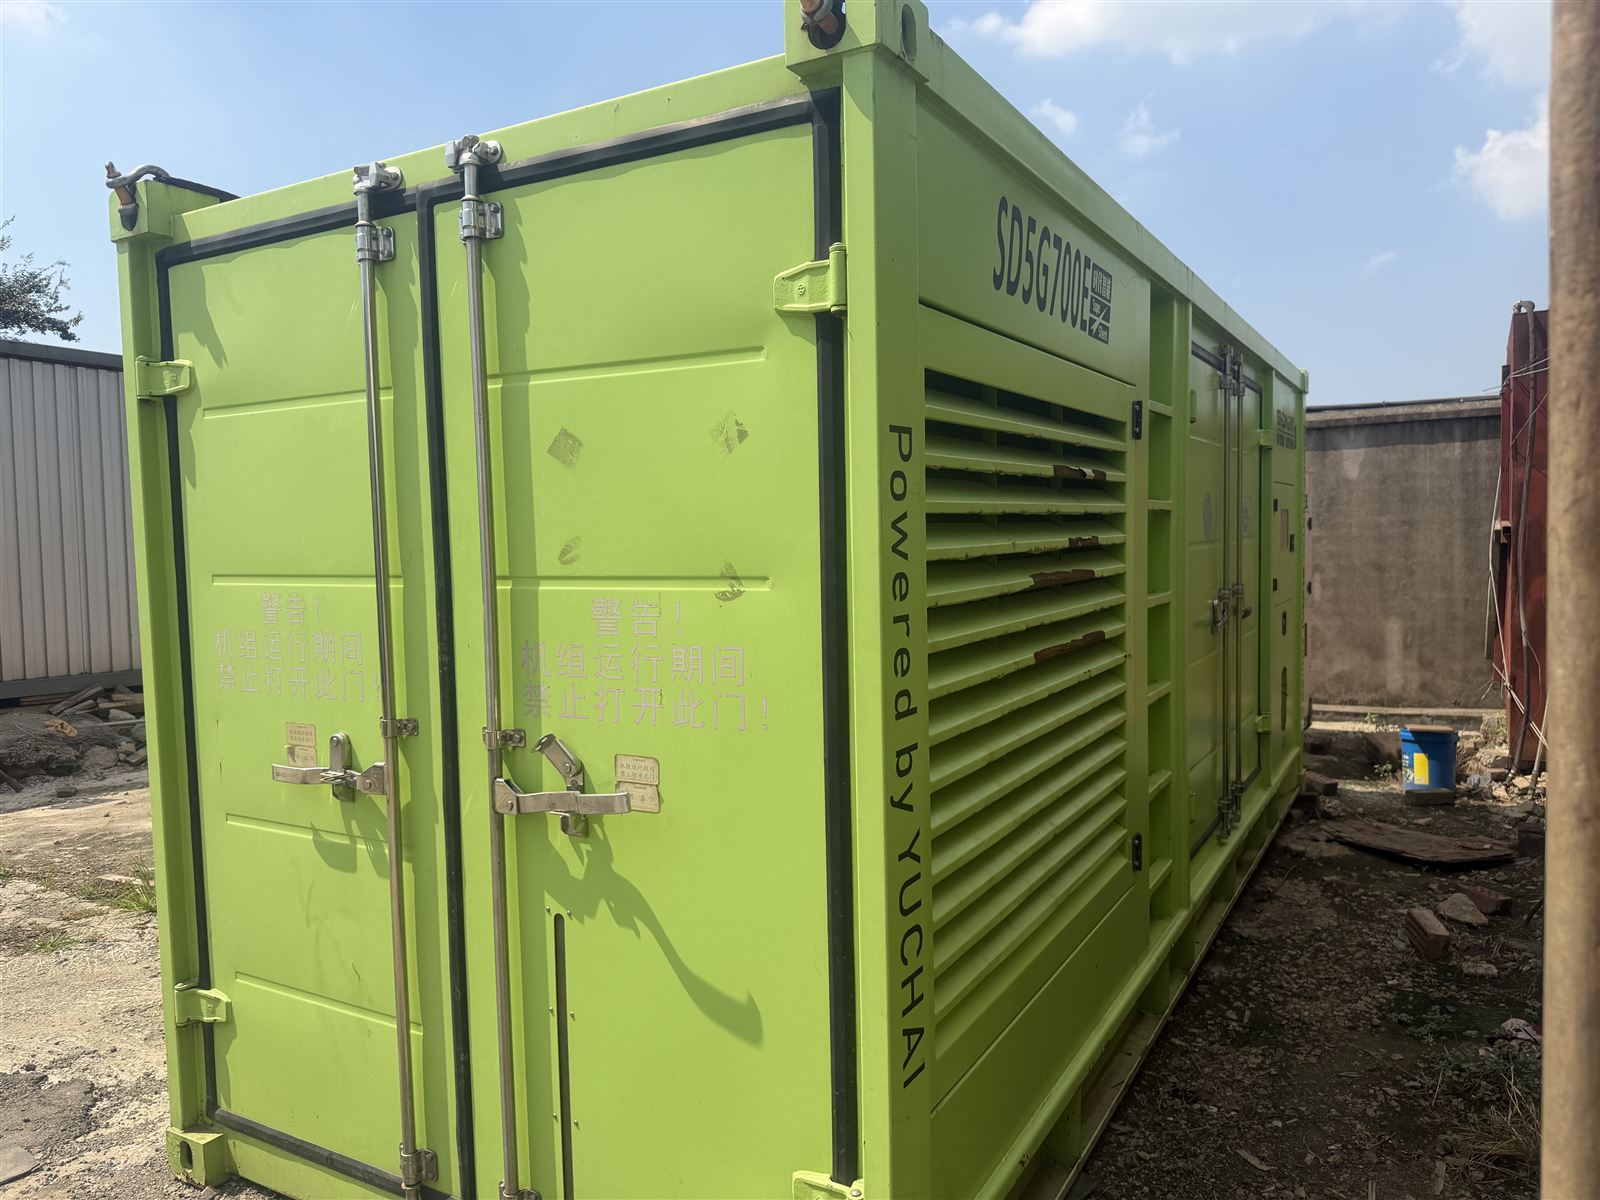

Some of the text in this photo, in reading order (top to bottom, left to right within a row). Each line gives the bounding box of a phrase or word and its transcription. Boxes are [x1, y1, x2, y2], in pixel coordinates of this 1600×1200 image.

[993, 196, 1092, 333] SD5G700E
[215, 628, 364, 666] 机组运行期间
[521, 640, 745, 687] 机组运行期间
[889, 424, 926, 1089] Powered by YUCHAI
